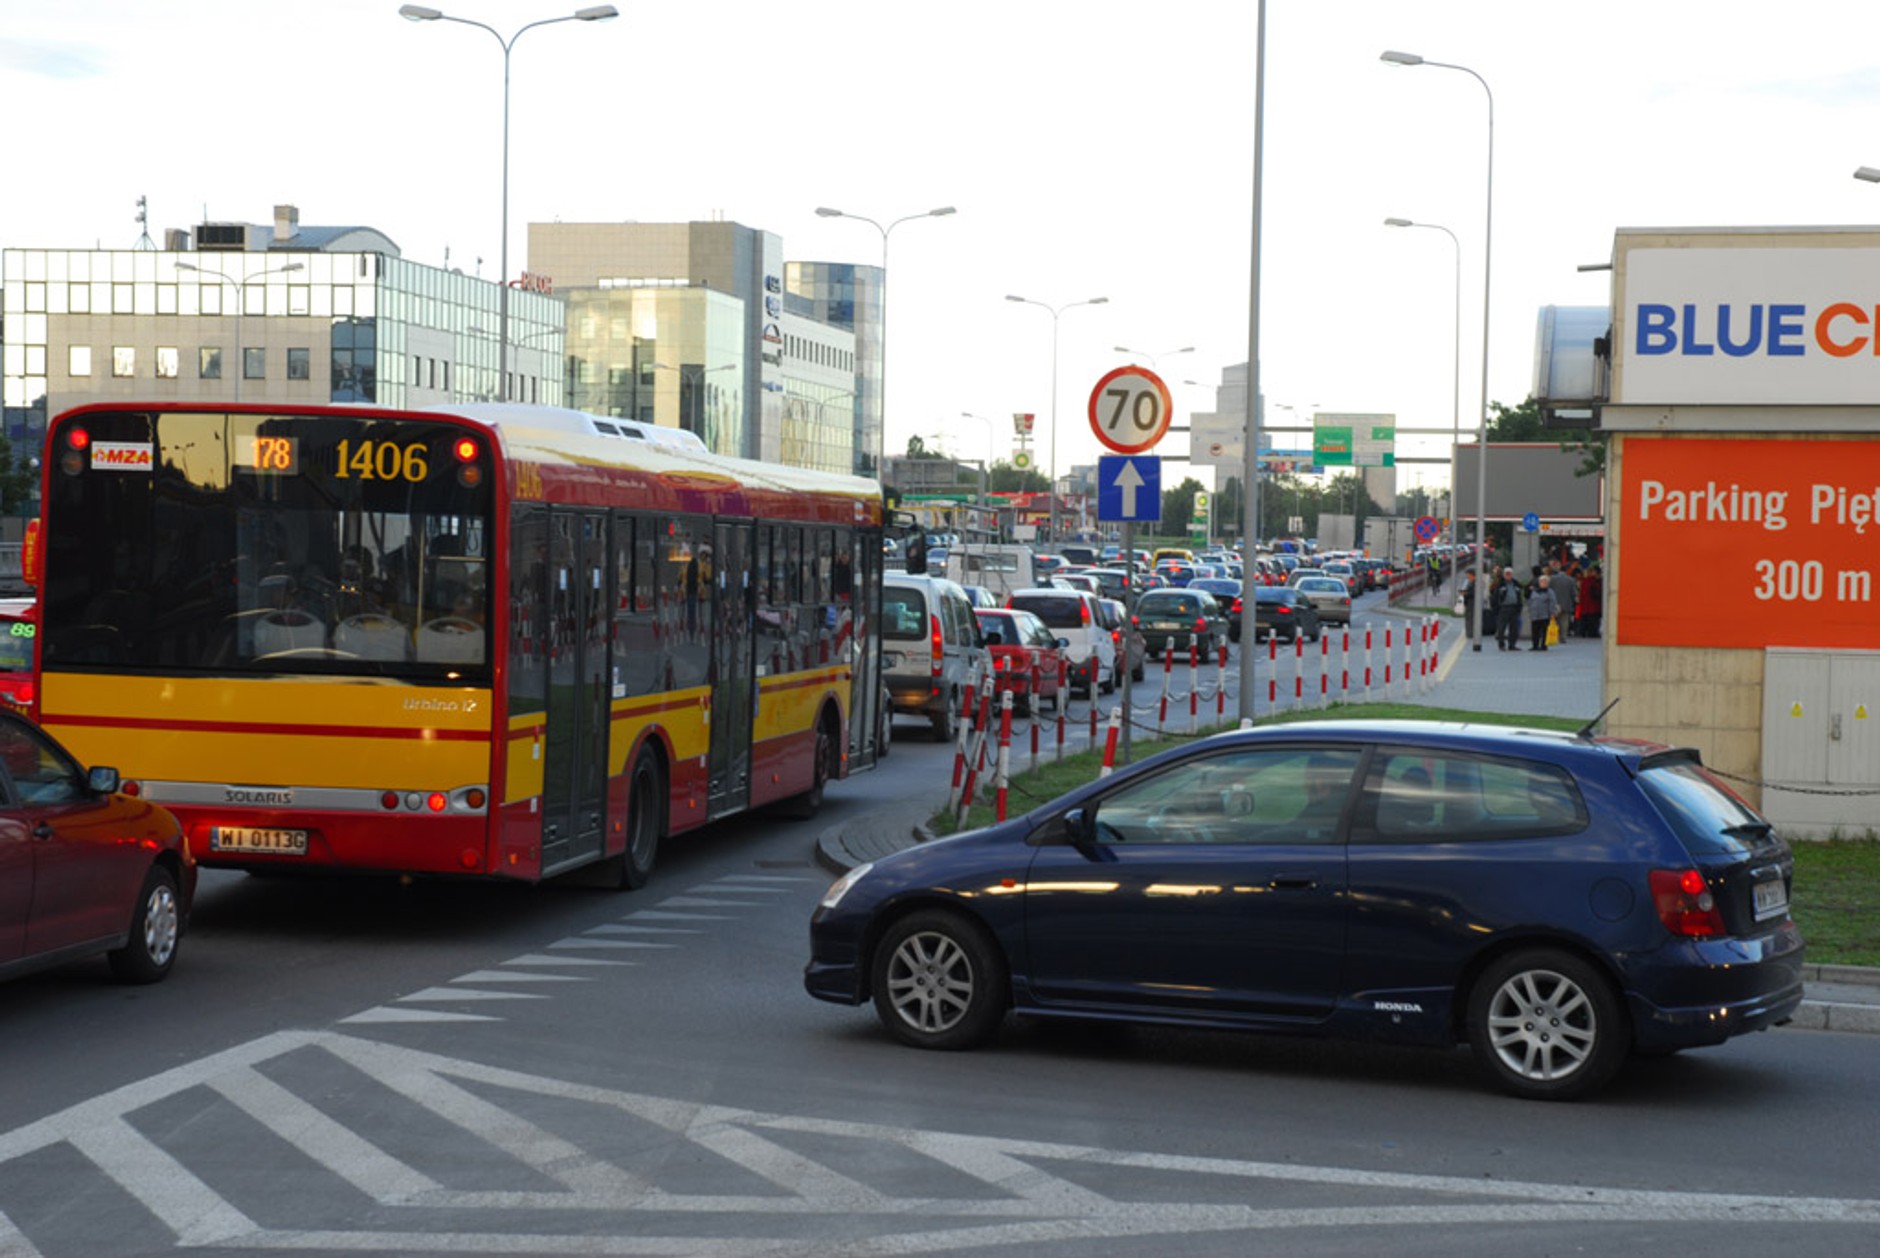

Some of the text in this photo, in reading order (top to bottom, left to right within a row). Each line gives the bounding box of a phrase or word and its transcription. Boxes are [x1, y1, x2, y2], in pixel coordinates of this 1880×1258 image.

[1106, 388, 1159, 431] 70
[106, 448, 150, 464] MZA
[252, 437, 291, 470] 178
[335, 438, 428, 482] 1406
[1640, 480, 1789, 530] Parking
[1754, 559, 1871, 601] 300 m
[10, 622, 36, 639] 89
[225, 790, 292, 805] SOLARIS
[1374, 1001, 1423, 1012] HONDA
